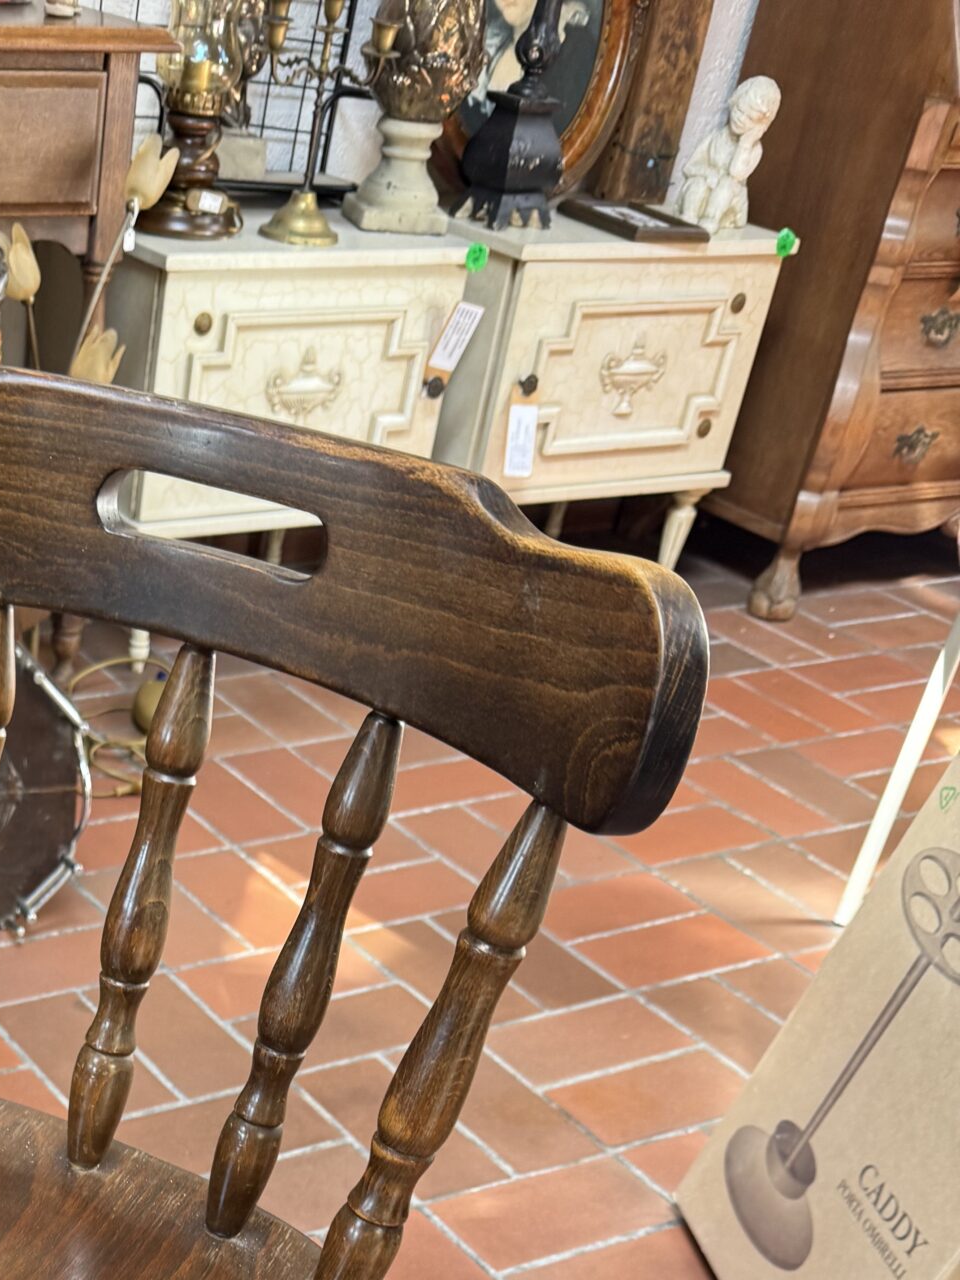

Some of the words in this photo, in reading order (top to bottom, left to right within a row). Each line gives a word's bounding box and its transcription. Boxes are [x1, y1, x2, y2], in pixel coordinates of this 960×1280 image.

[836, 1179, 865, 1222] PORTA
[862, 1218, 907, 1280] OMBRELLI
[858, 1164, 929, 1258] CADDY
